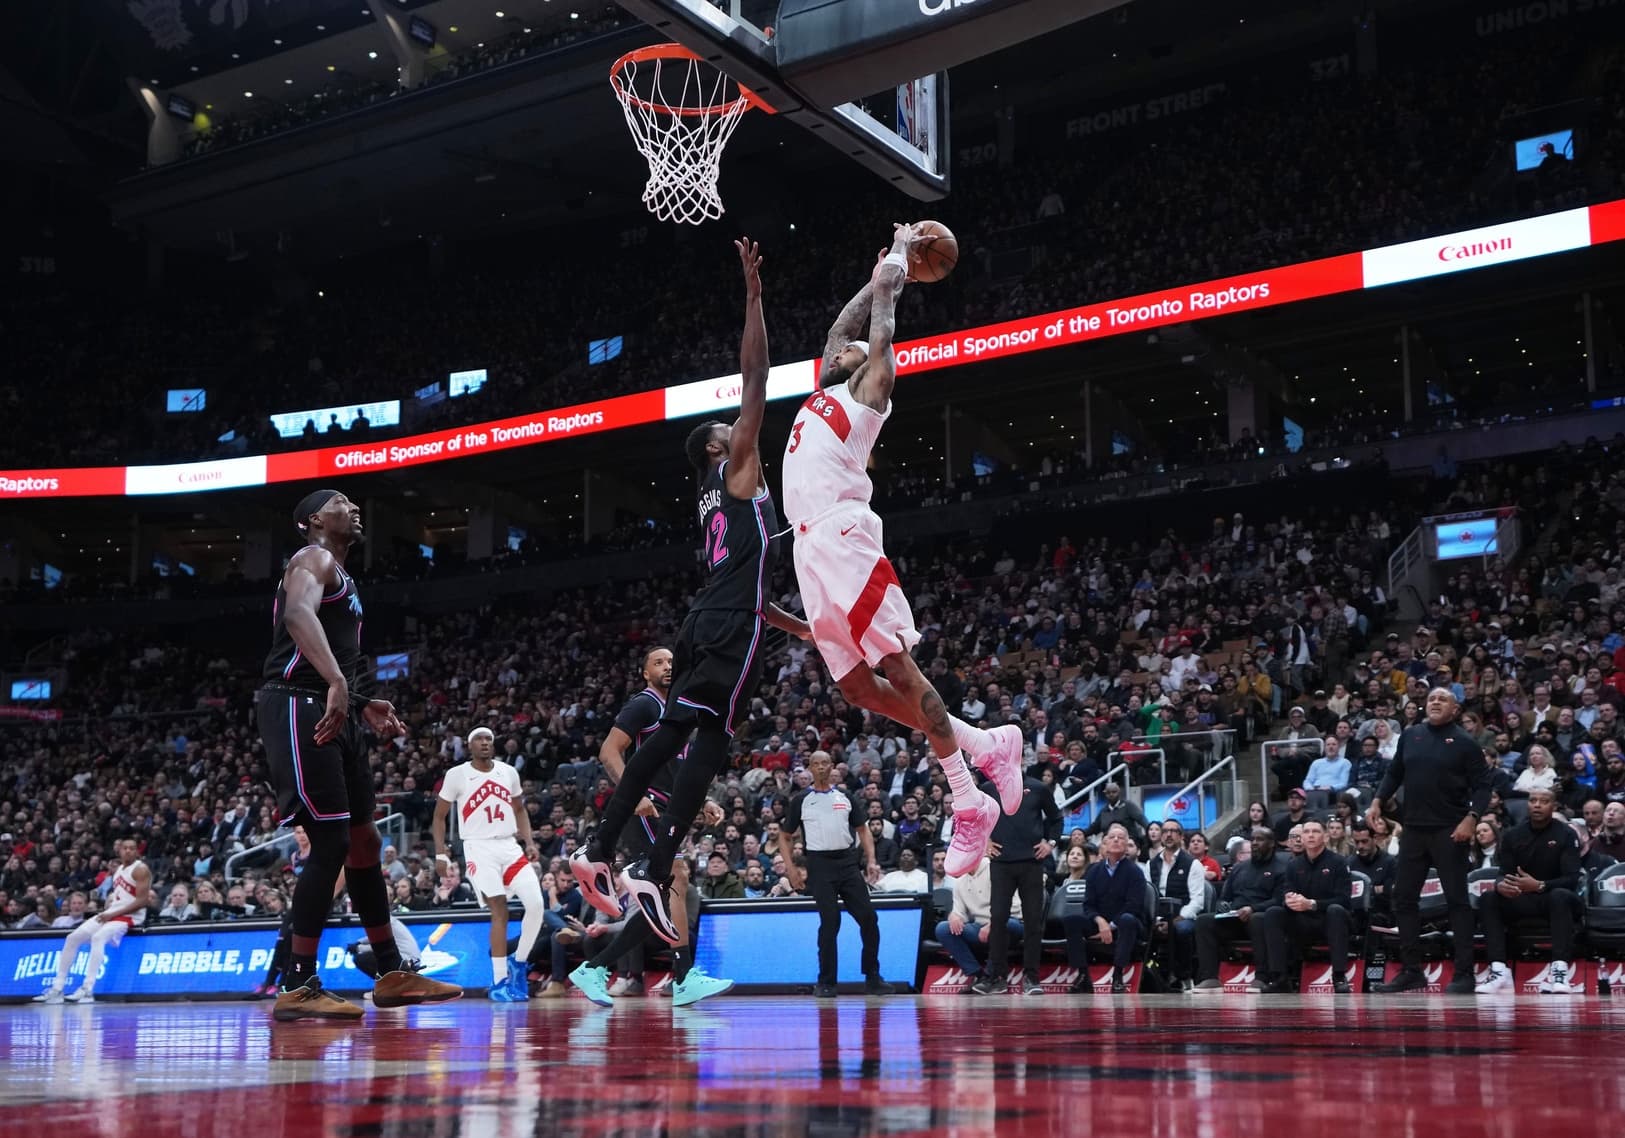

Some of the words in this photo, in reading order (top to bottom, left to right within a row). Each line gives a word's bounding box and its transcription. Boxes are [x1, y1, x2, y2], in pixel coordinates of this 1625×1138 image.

[1474, 0, 1568, 38] UNION
[1065, 104, 1142, 139] FRONT
[1439, 238, 1512, 261] Canon
[896, 339, 958, 367] Official
[963, 327, 1039, 356] Sponsor
[1044, 318, 1065, 339] of
[1069, 315, 1101, 334] the
[1106, 299, 1184, 326] Toronto
[1189, 283, 1270, 311] Raptors
[334, 447, 387, 468] Official
[390, 440, 445, 463] Sponsor
[447, 434, 463, 451] of
[464, 431, 488, 448] the
[490, 421, 545, 443] Toronto
[547, 411, 604, 434] Raptors
[789, 420, 805, 454] 3
[470, 783, 512, 808] RAPTORS
[484, 804, 504, 823] 14
[137, 949, 244, 975] DRIBBLE,
